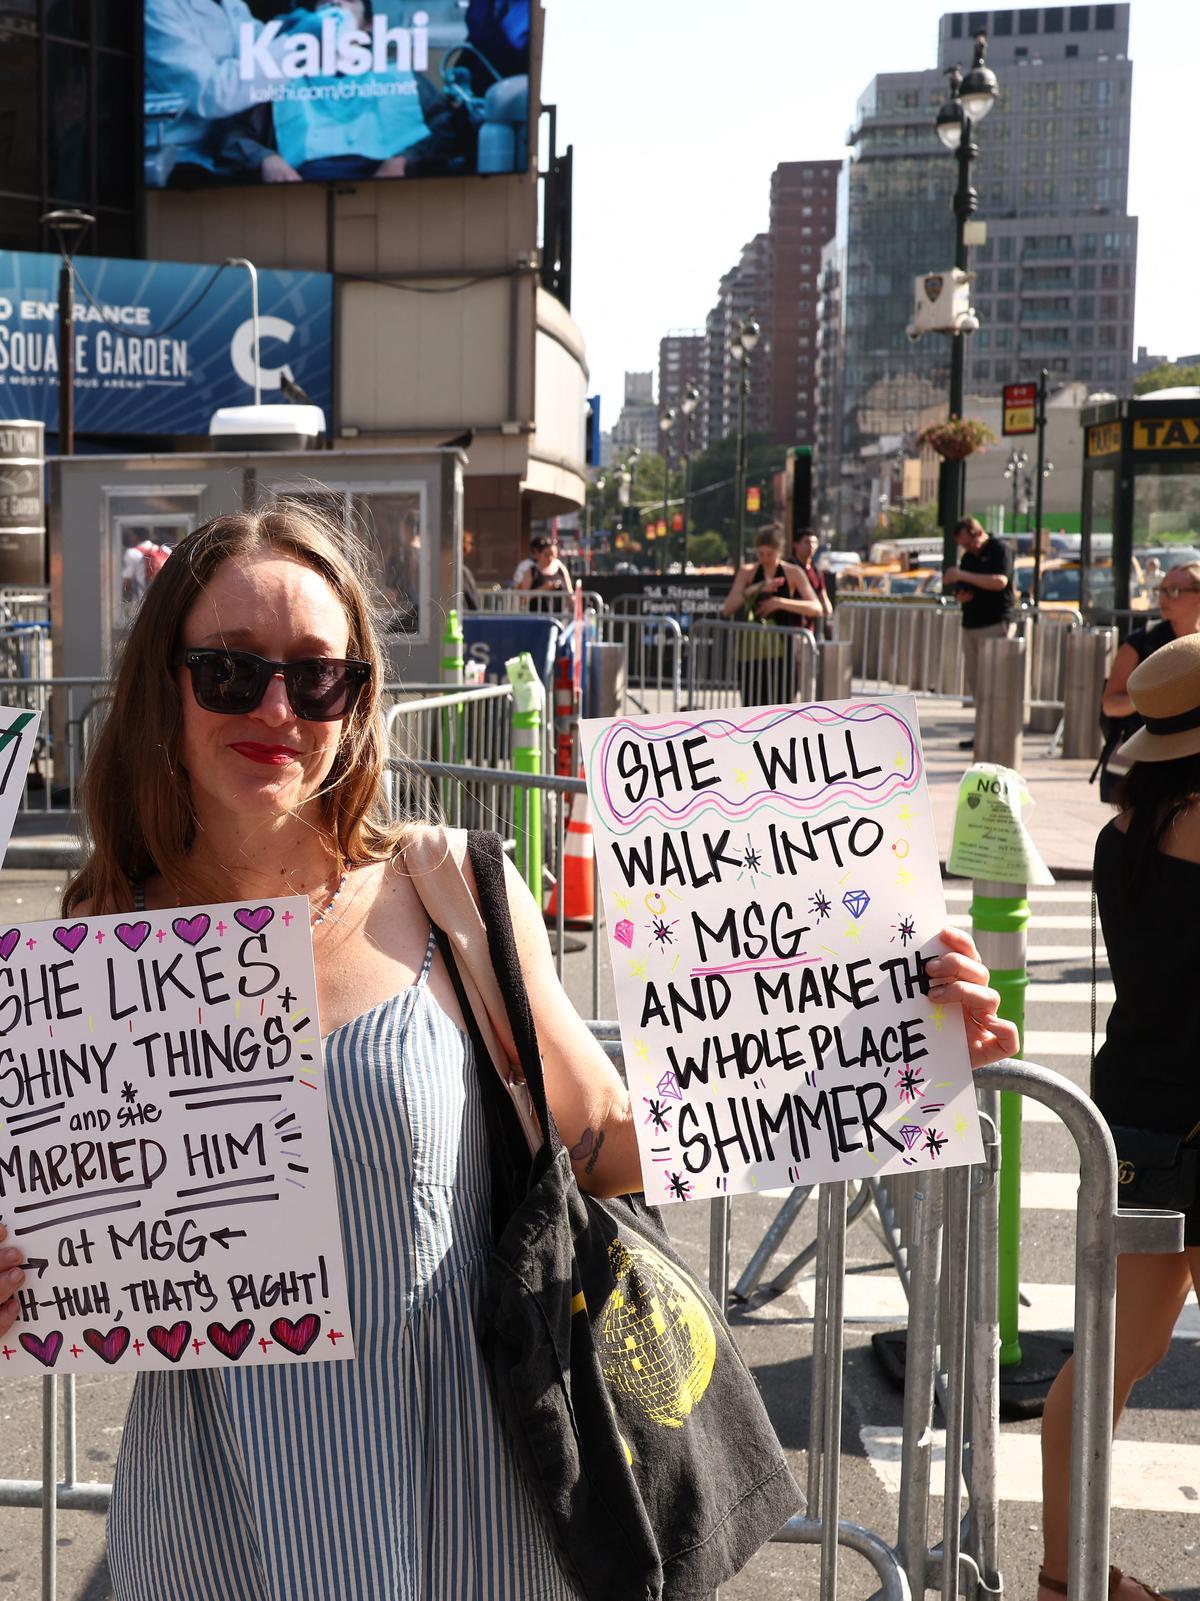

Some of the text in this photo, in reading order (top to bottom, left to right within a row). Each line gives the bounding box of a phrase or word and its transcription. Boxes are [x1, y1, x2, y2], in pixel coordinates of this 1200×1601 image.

[239, 11, 429, 80] Kalshi
[250, 80, 419, 102] kalshi.com/chalamet
[10, 376, 44, 387] MOST
[96, 331, 189, 377] GARDEN
[667, 585, 710, 599] Street
[617, 729, 883, 804] SHE WILL
[611, 815, 884, 889] WALK INTO
[691, 901, 811, 963] MSG
[106, 933, 281, 1021] LIKES
[641, 974, 732, 1033] AND
[755, 958, 875, 1015] MAKE
[133, 1015, 292, 1078] THINGS
[666, 1017, 929, 1090] WHOLE PLACE
[184, 1122, 267, 1179] HIM
[677, 1080, 905, 1174] SHIMMER
[57, 1218, 208, 1267] at MSG
[12, 1254, 331, 1322] H-HUH, THAT'S RIGHT!
